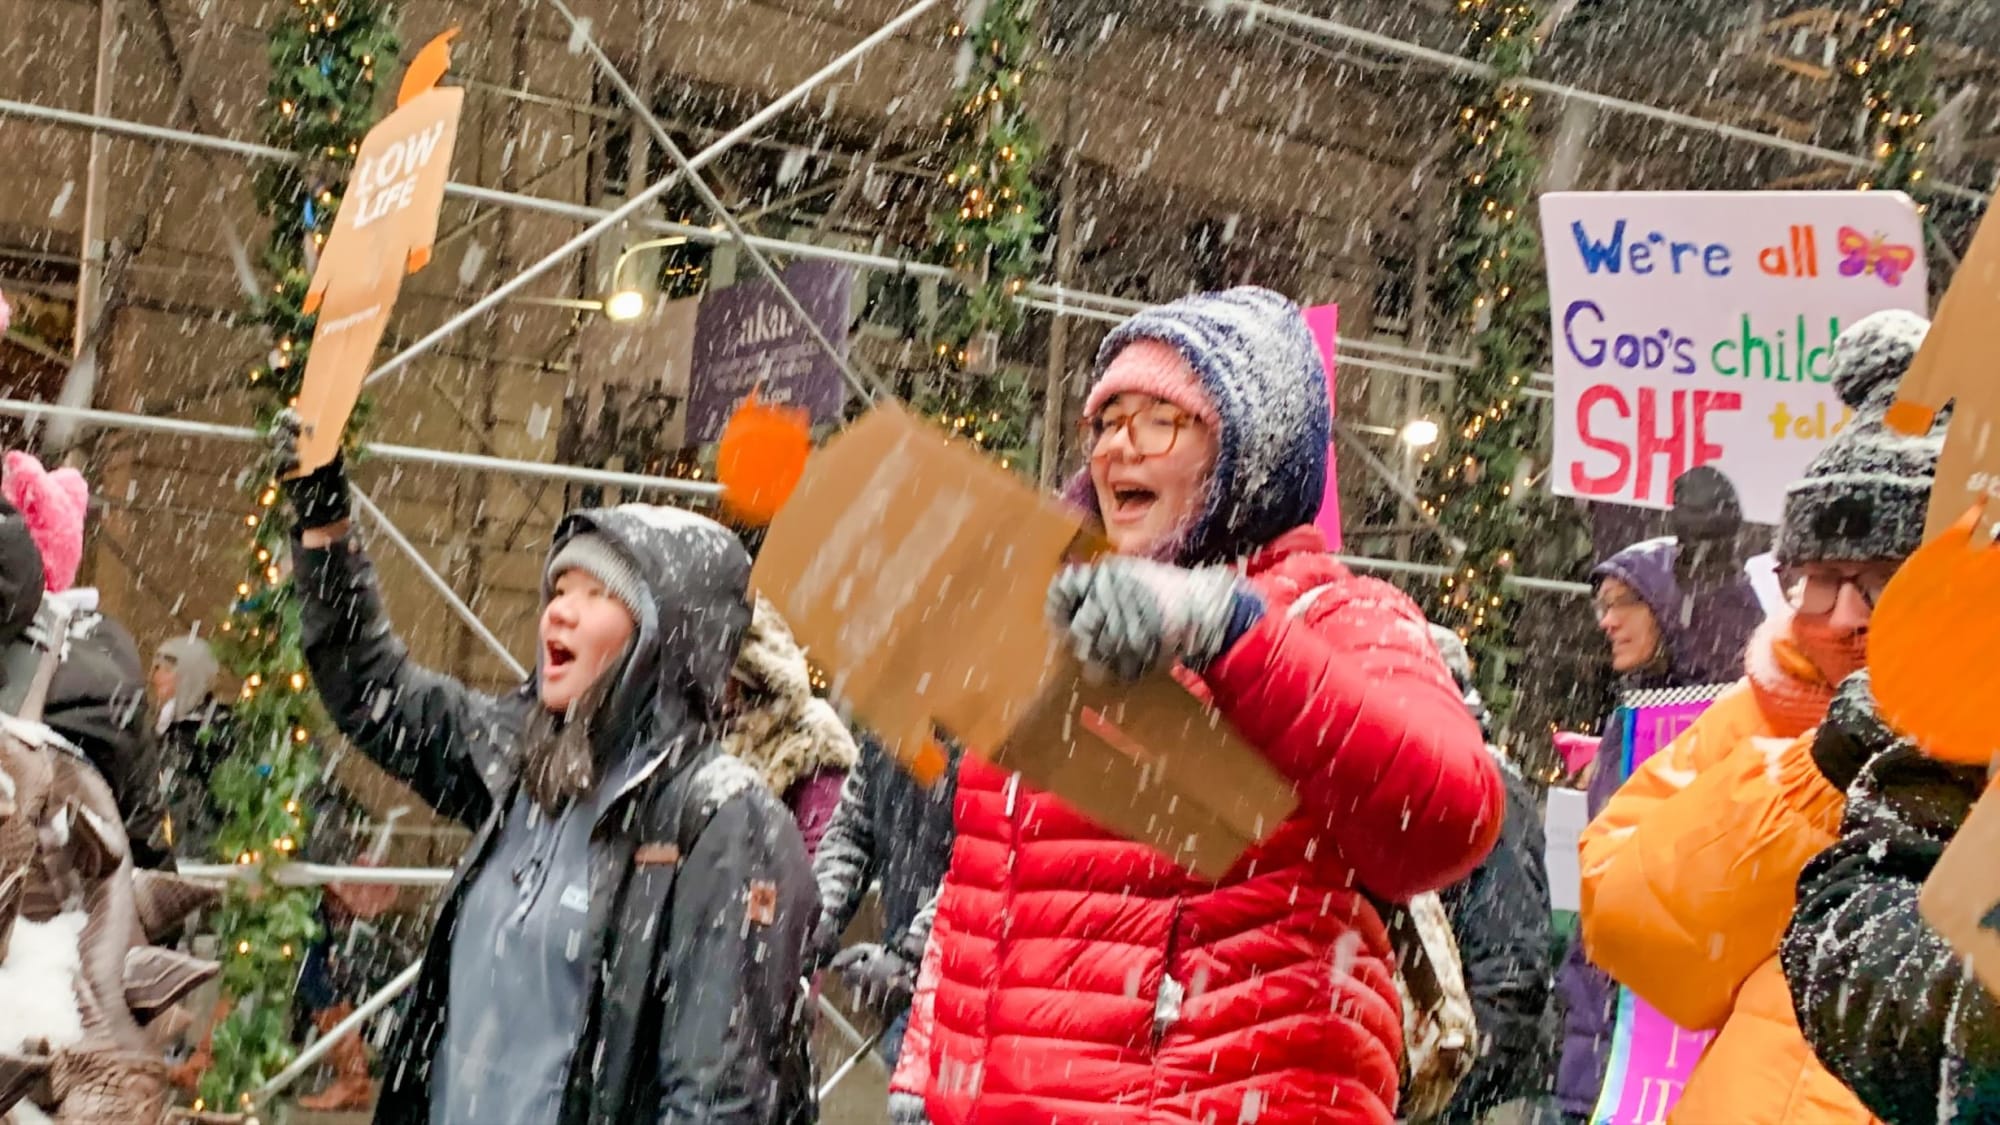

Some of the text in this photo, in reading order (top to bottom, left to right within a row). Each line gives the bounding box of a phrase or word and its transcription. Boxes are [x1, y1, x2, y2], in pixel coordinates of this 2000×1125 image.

[354, 120, 445, 199] LOW
[351, 173, 419, 231] LIFE
[1570, 219, 1818, 278] We're all
[1570, 384, 1742, 505] SHE
